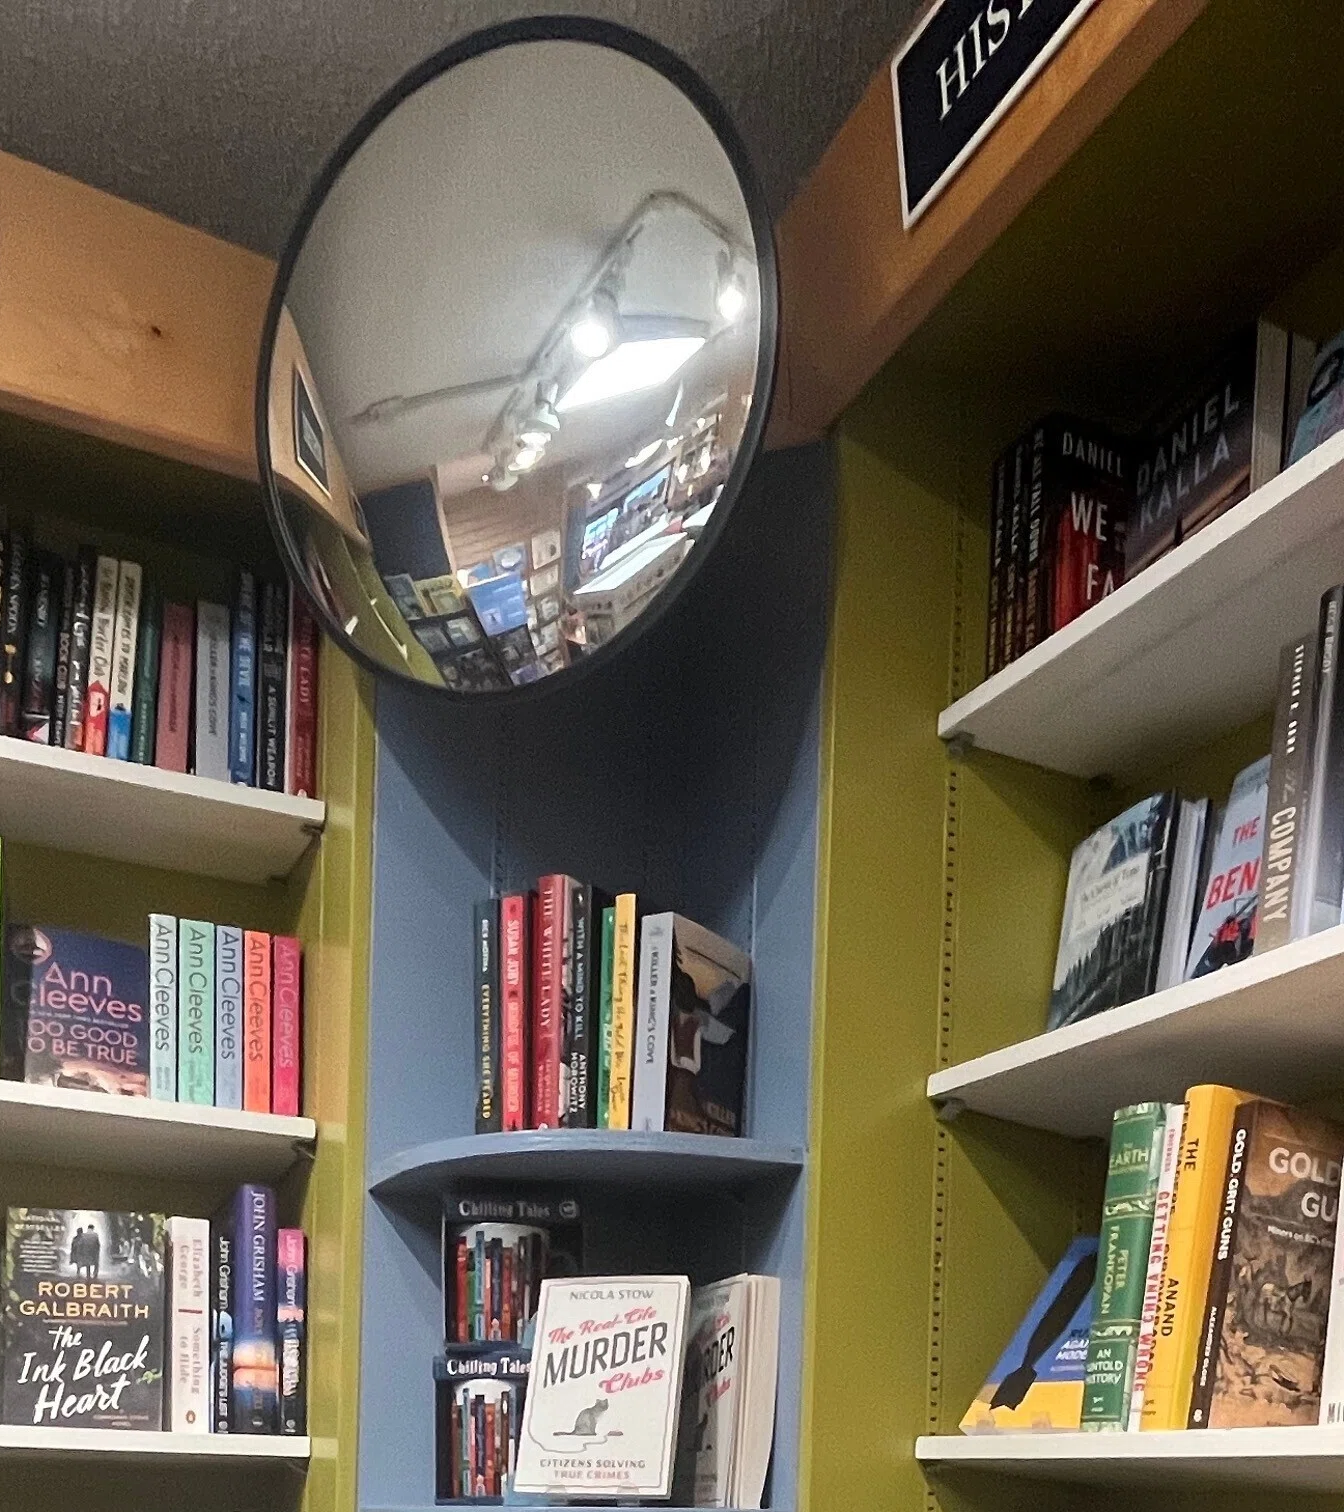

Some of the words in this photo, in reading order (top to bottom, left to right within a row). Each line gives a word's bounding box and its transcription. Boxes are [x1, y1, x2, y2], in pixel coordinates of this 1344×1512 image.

[36, 1281, 135, 1298] ROBERT
[570, 1290, 615, 1300] NICOLA
[619, 1289, 655, 1300] STOW
[19, 1300, 150, 1319] GALBRAITH
[17, 1350, 65, 1384] Ink
[73, 1334, 150, 1381] Black
[543, 1321, 668, 1388] MURDER
[599, 1368, 665, 1395] Clubs
[33, 1373, 131, 1424] Heart
[539, 1458, 592, 1469] CITIZENS
[596, 1458, 646, 1469] SOLVING
